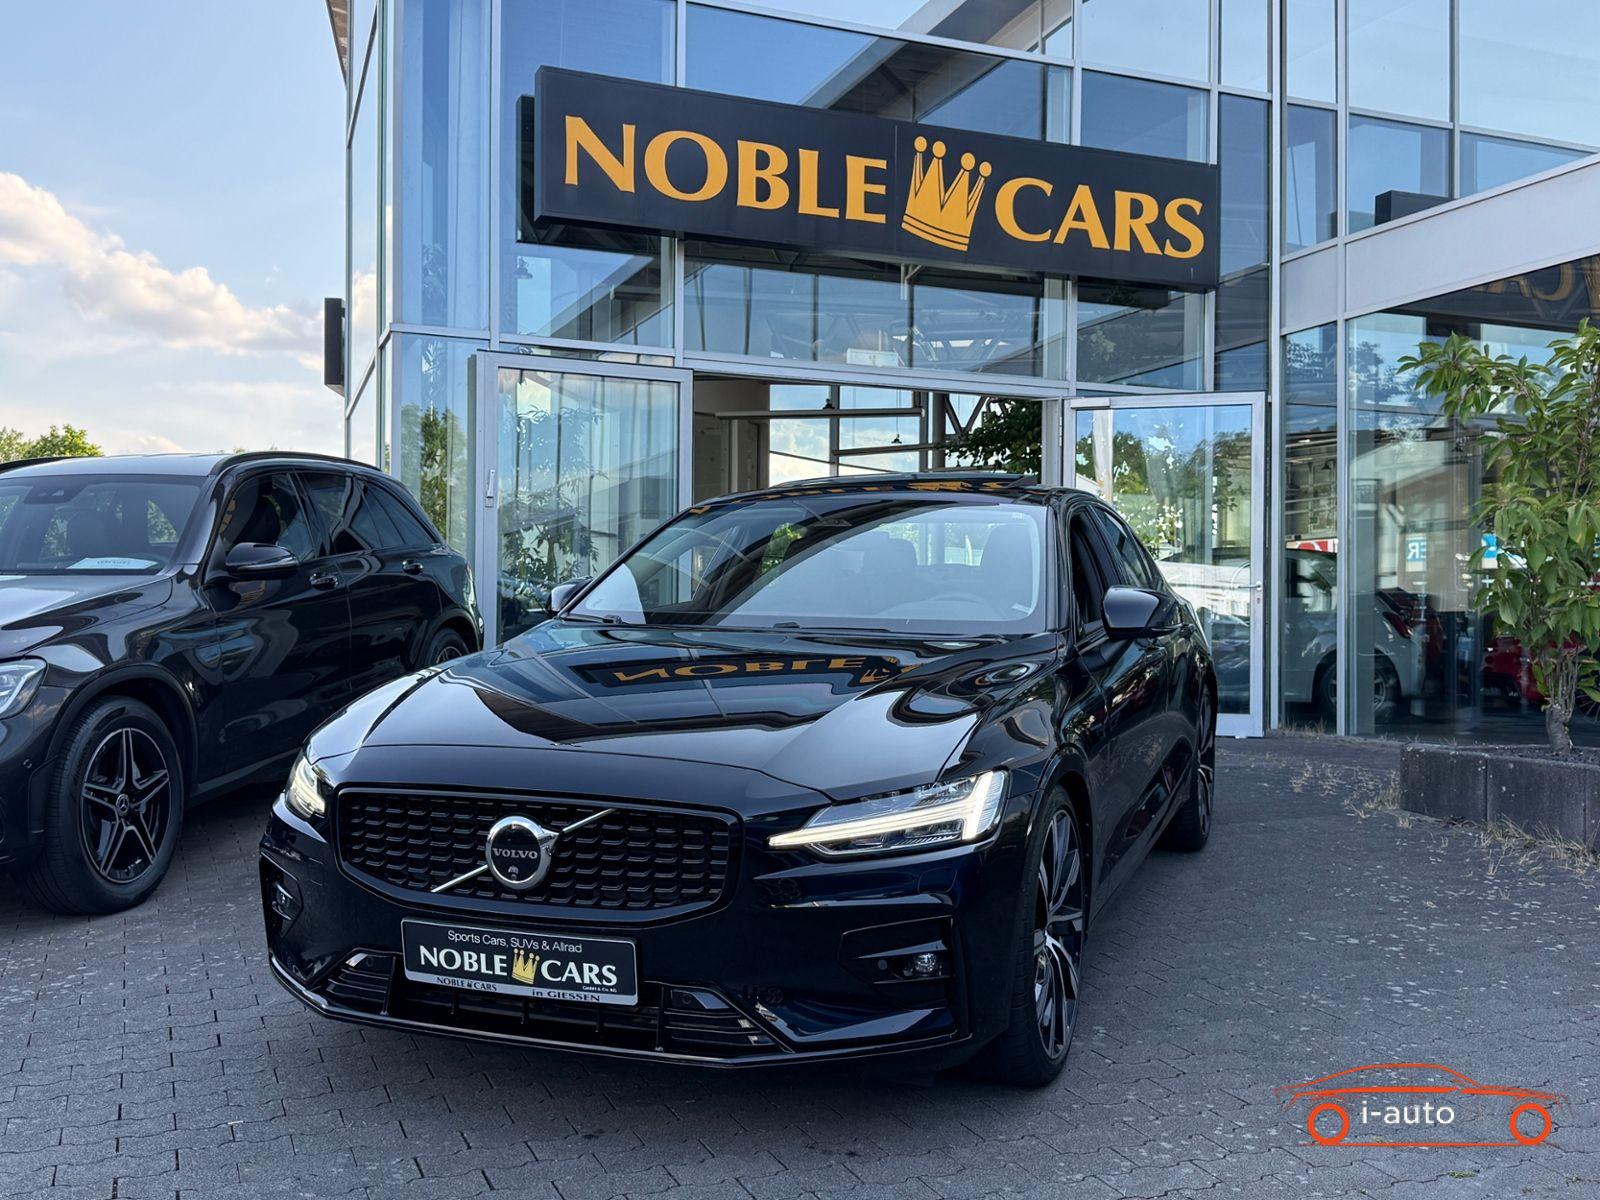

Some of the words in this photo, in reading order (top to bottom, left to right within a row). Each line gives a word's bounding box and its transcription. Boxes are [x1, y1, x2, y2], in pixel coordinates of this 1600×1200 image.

[564, 114, 888, 225] NOBLE
[994, 176, 1205, 259] CARS
[492, 847, 538, 859] VOLVO
[447, 930, 481, 944] Sports
[482, 934, 509, 948] Cars,
[510, 937, 540, 950] SUVs
[541, 940, 550, 951] &
[552, 941, 582, 953] Allrad
[419, 945, 508, 976] NOBLE
[541, 960, 618, 986] CARS
[436, 976, 466, 988] NOBLE
[474, 981, 498, 992] CARS
[532, 988, 543, 997] in
[547, 990, 600, 1002] GIESSEN
